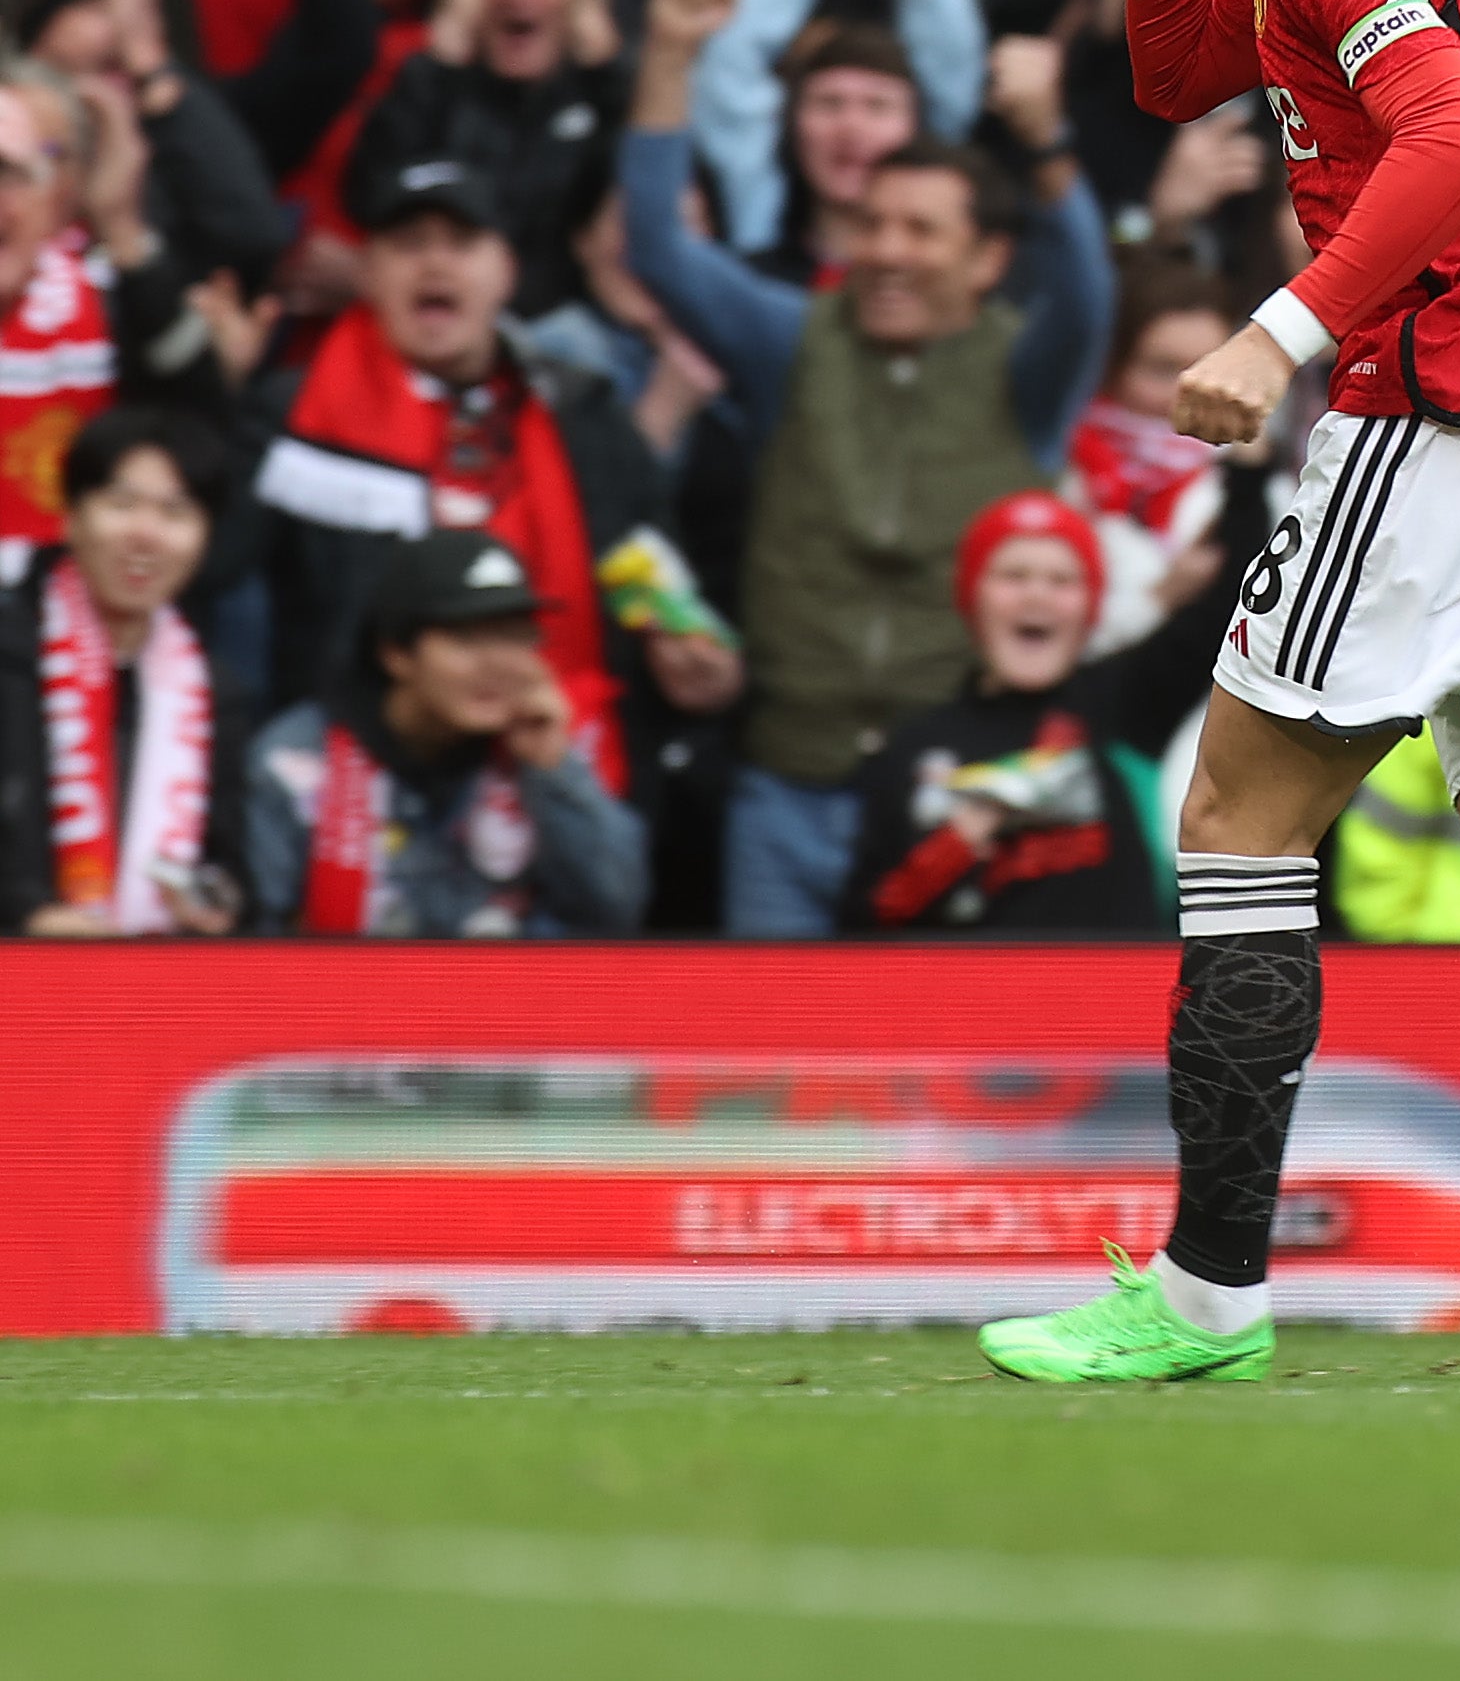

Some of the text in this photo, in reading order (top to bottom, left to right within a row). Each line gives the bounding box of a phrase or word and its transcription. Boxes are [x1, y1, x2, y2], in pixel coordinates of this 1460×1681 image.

[1343, 8, 1425, 69] captain
[1241, 514, 1302, 615] 8
[675, 1182, 1172, 1256] ELECTROLYT
